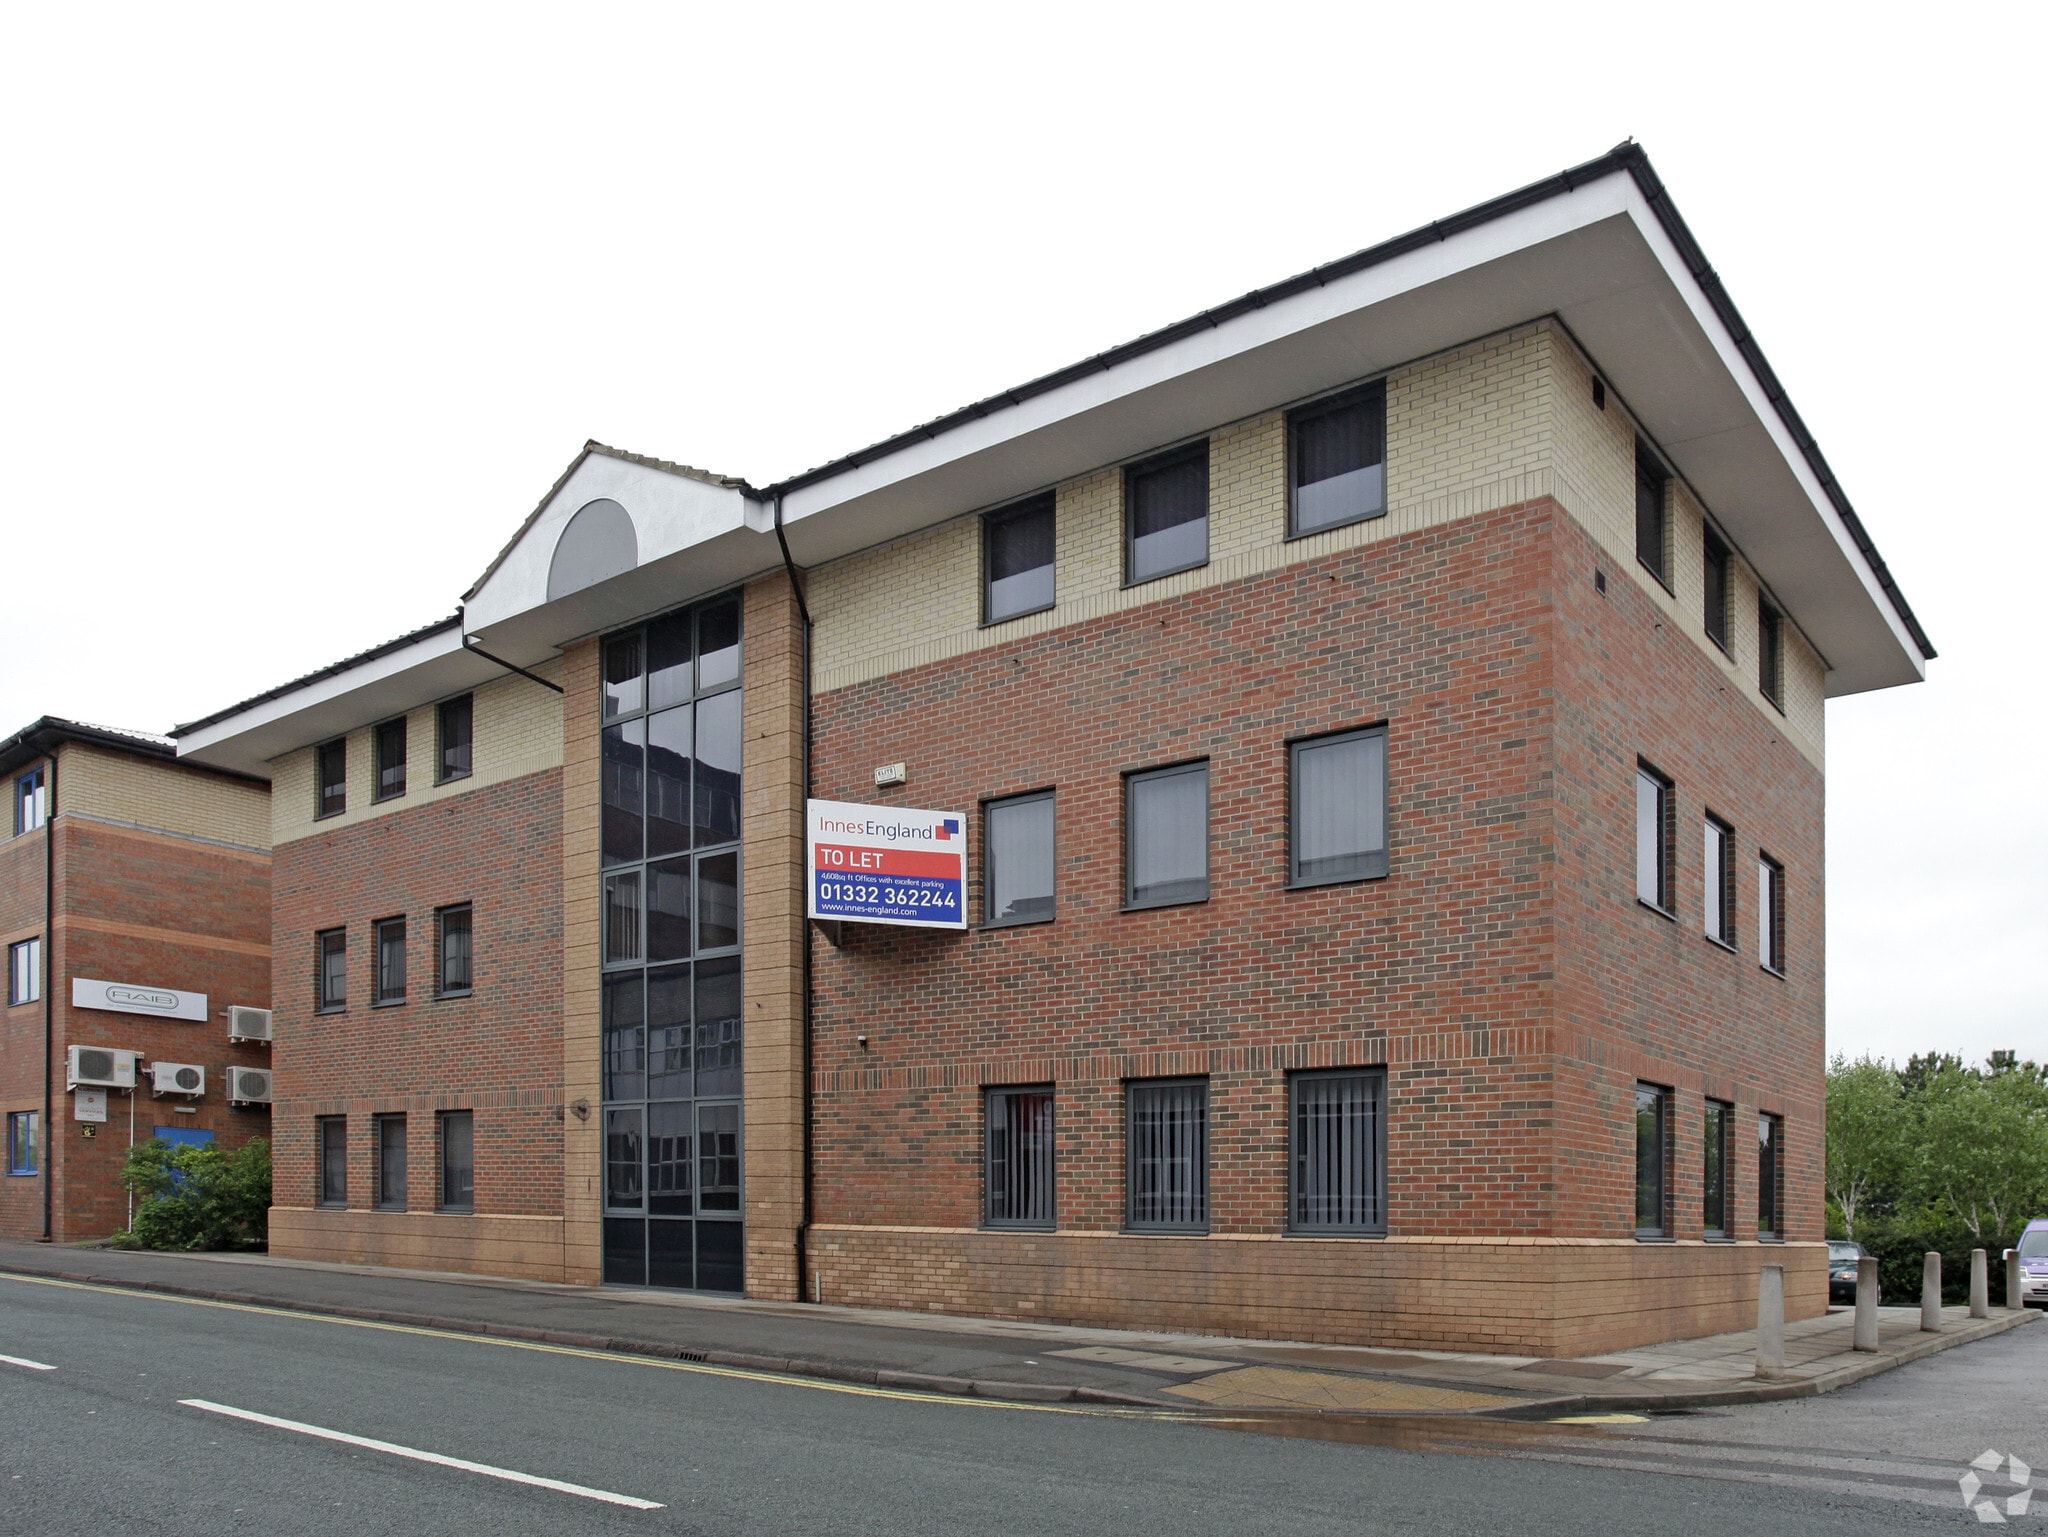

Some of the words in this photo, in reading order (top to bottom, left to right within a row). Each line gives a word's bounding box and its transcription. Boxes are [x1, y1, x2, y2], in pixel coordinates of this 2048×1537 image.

[820, 848, 844, 865] TO
[849, 851, 883, 869] LET
[847, 873, 854, 881] ft
[855, 874, 877, 883] Offices
[878, 876, 893, 884] with
[894, 878, 920, 886] excellent
[921, 879, 944, 889] parking
[820, 883, 879, 903] 01332
[884, 888, 955, 908] 362244
[821, 904, 917, 916] www.innes-england.com
[112, 991, 173, 1004] RAIB
